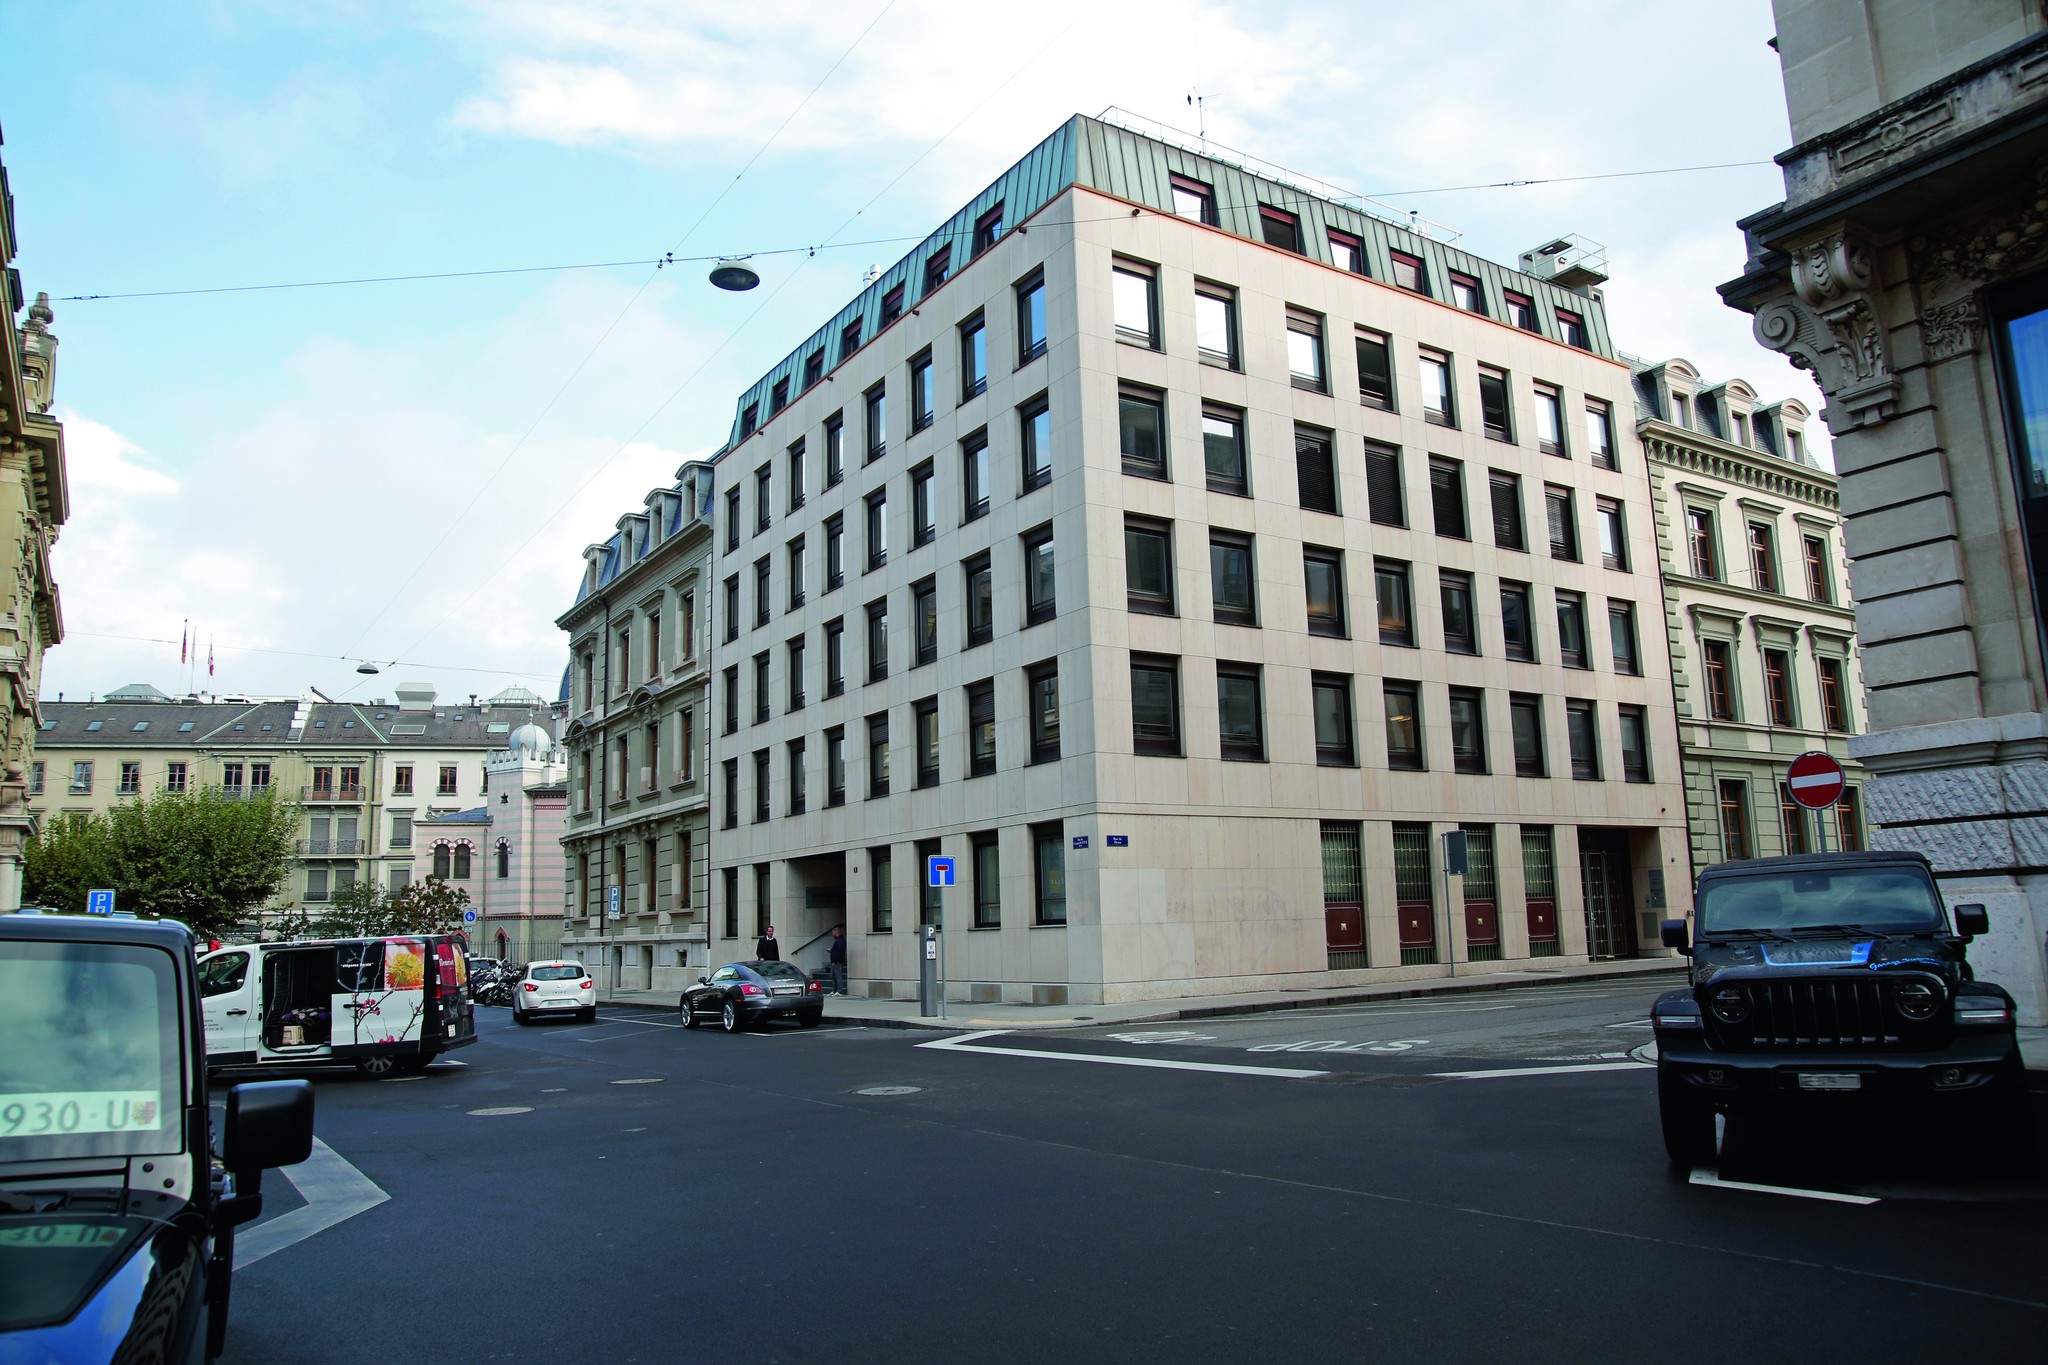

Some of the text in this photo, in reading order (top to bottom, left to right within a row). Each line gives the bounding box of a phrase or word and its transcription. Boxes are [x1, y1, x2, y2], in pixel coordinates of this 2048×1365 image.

[97, 893, 107, 906] P
[612, 888, 618, 900] P
[928, 926, 935, 937] P
[1869, 960, 1901, 971] Garage
[1246, 1040, 1431, 1052] STOP
